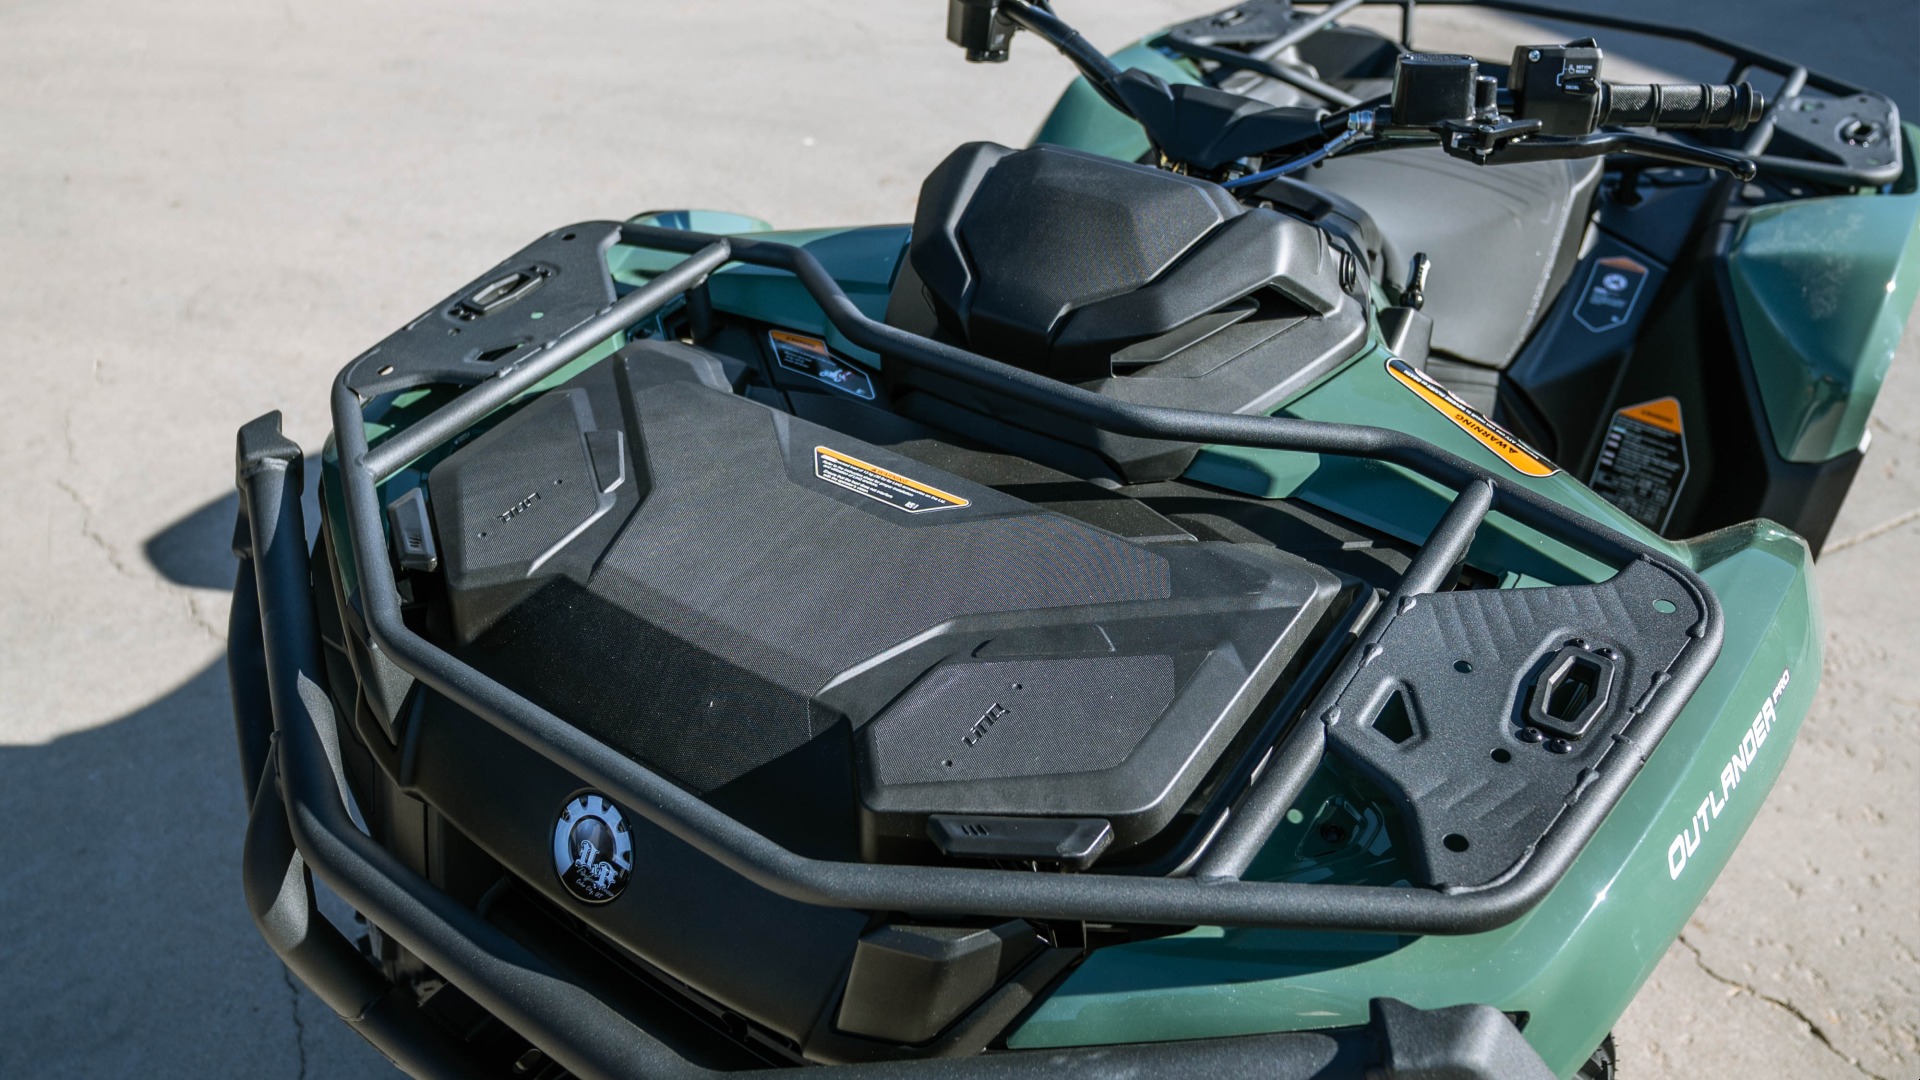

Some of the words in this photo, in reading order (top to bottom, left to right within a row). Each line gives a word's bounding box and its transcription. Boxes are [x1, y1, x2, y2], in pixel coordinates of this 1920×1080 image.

[1455, 414, 1507, 449] WARNING
[1668, 697, 1777, 880] OUTLANDER
[1772, 669, 1791, 705] PRO
